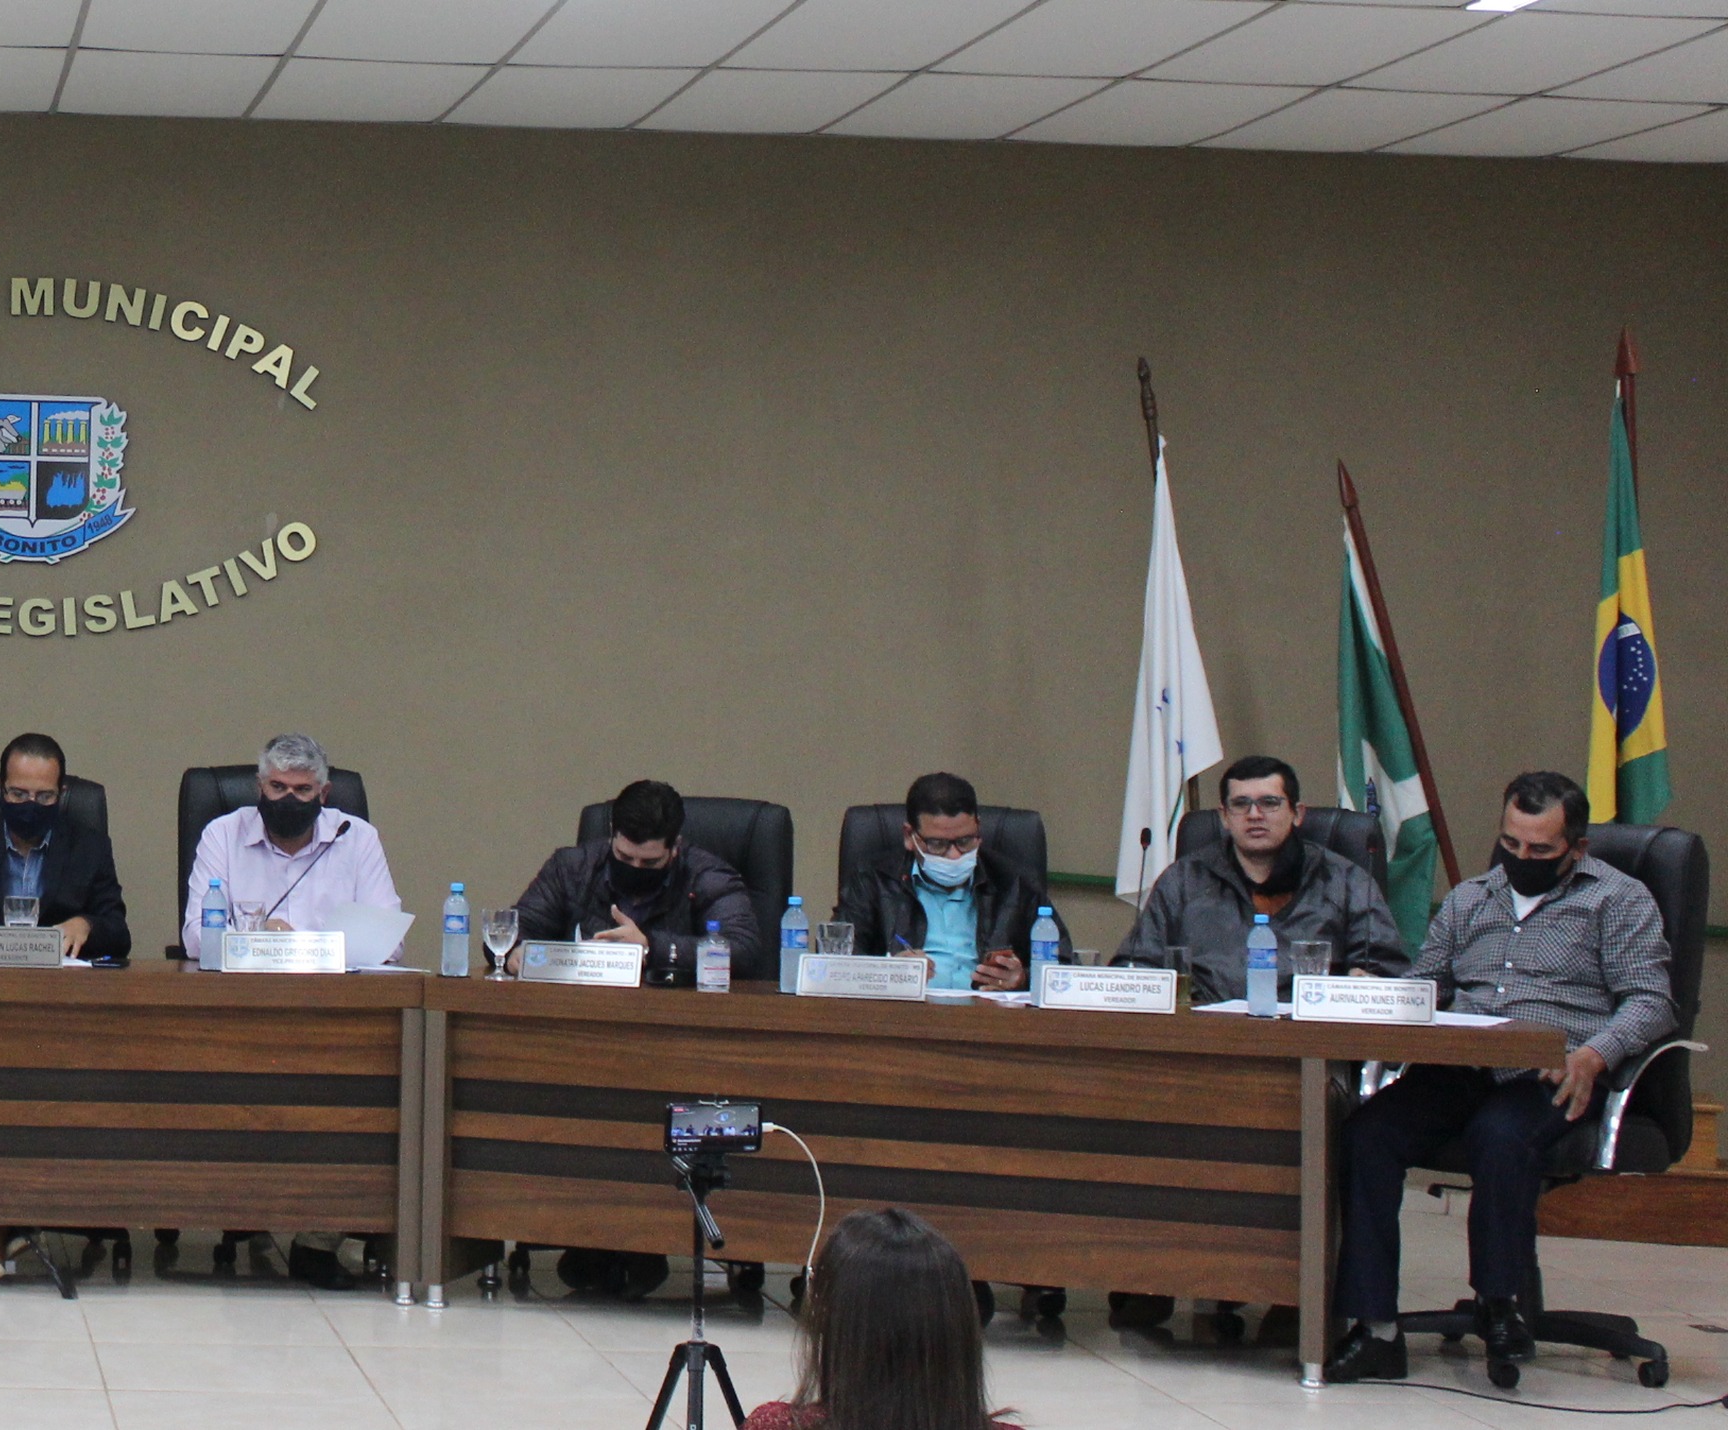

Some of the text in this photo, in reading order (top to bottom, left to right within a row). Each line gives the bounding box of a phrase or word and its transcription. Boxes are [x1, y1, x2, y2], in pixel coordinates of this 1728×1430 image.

[10, 277, 321, 411] MUNICIPAL
[5, 942, 28, 952] LUCAS
[28, 943, 56, 953] RACHEL
[252, 947, 283, 957] EDNALDO
[578, 959, 606, 969] JACQUES
[606, 960, 634, 971] MARQUES
[1079, 981, 1162, 994] LUCAS LEANDRO PAES
[1329, 993, 1426, 1006] AURIVALDO NUNES FRANÇA
